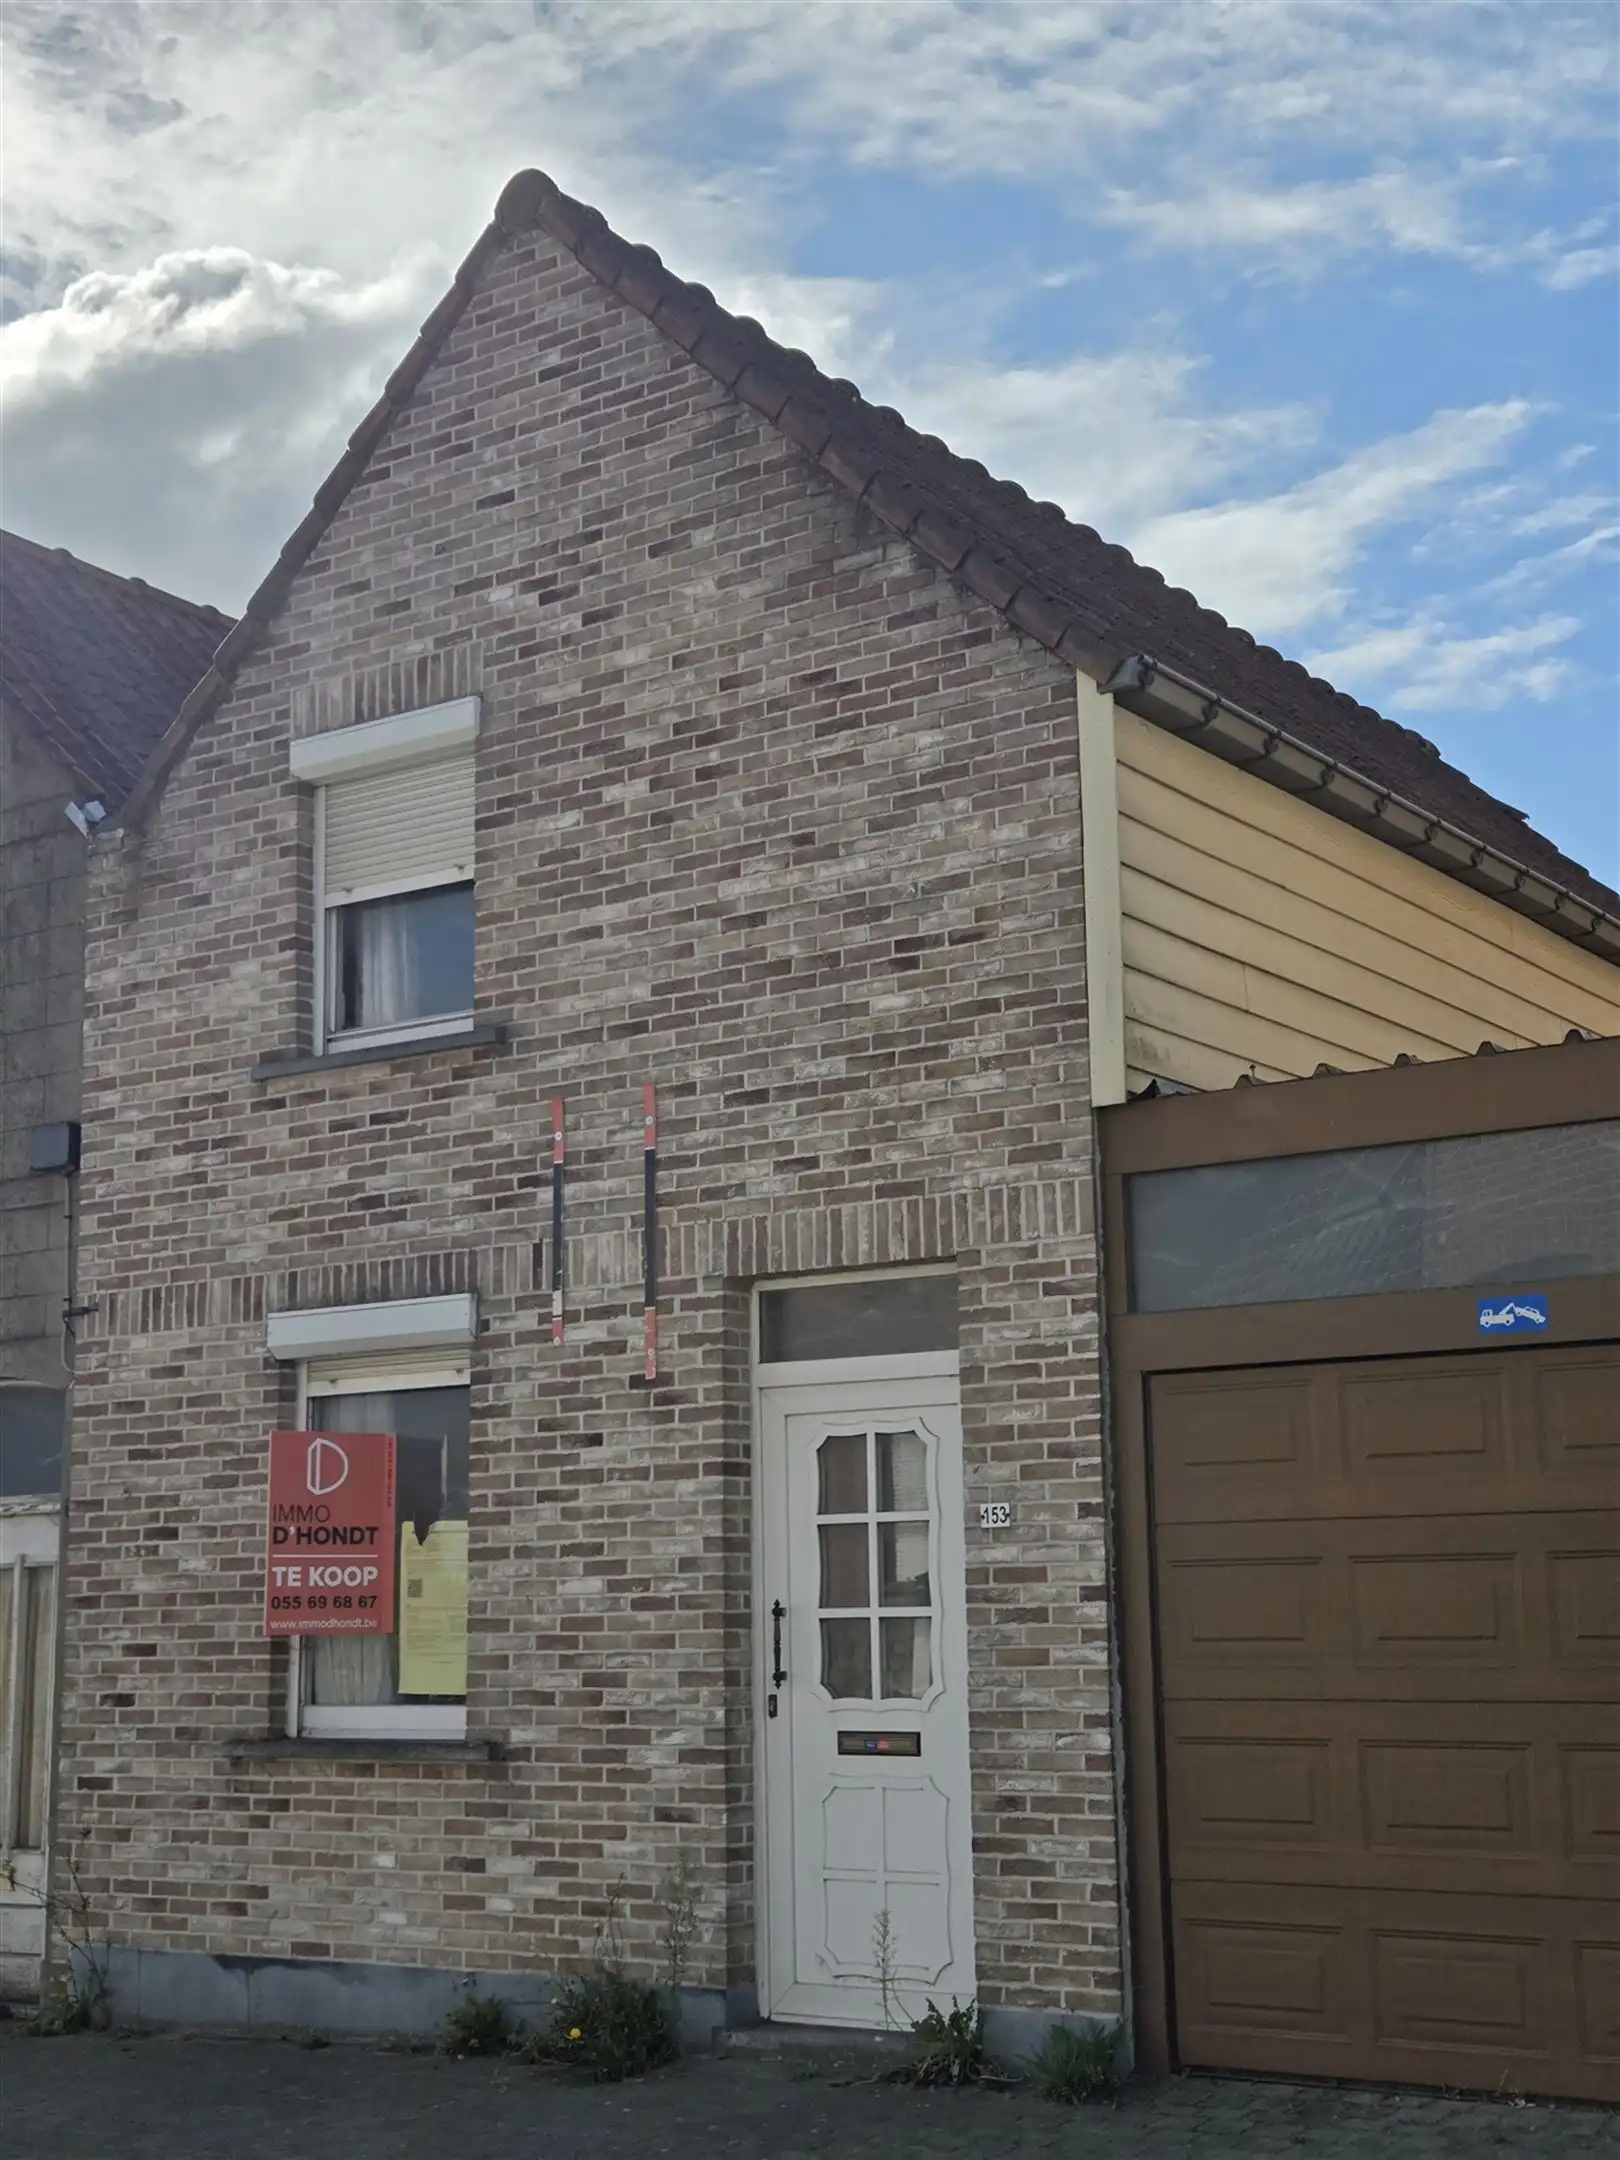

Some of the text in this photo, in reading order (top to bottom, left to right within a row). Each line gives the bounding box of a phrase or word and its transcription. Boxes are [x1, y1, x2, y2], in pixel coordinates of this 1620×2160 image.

[273, 1504, 331, 1523] IMMO
[983, 1506, 1007, 1524] 153
[272, 1526, 379, 1545] D'HONDT
[272, 1566, 378, 1587] TE KOOP
[271, 1595, 378, 1610] 055 69 68 67
[270, 1617, 378, 1629] www.immodhondt.be
